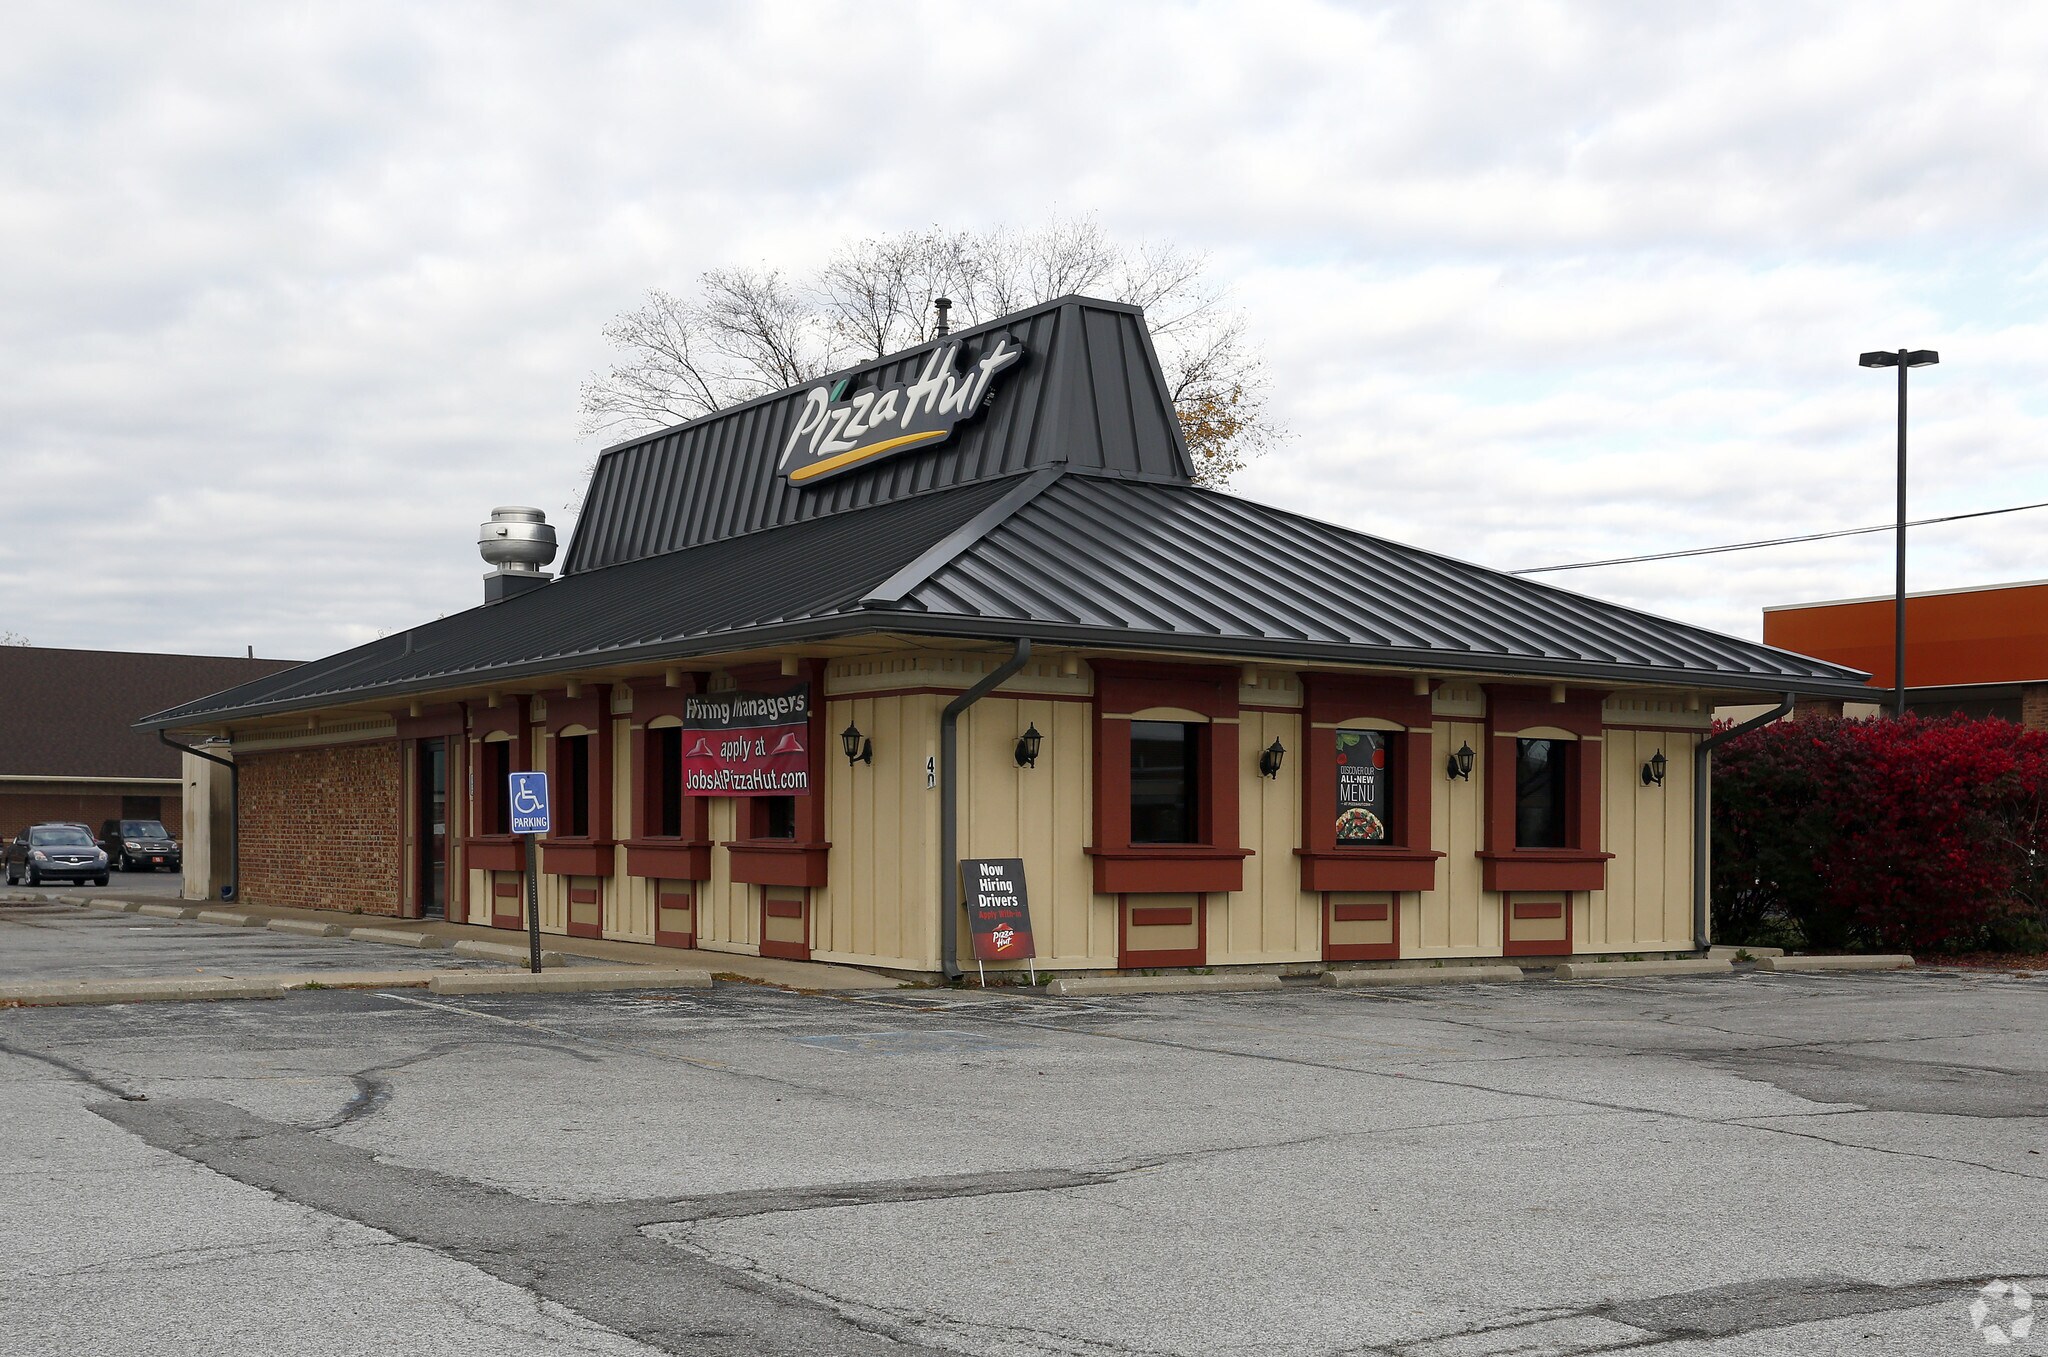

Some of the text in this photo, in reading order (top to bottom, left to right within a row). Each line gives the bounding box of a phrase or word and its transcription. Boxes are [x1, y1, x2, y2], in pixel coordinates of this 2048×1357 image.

[779, 340, 1017, 470] Pizza Hut
[686, 694, 805, 724] Hiring Managers
[720, 735, 766, 762] apply at
[1340, 766, 1375, 775] DISCOVER OUR
[686, 768, 807, 790] JobsAtPizzaHut.com
[1340, 775, 1374, 784] ALL-NEW
[1340, 783, 1375, 802] MENU
[514, 817, 547, 828] PARKING
[979, 863, 1003, 876] Now
[979, 878, 1013, 894] Hiring
[978, 894, 1018, 907] Drivers
[979, 911, 997, 919] Apply
[992, 930, 1014, 943] Pizza
[997, 936, 1013, 948] Hut
